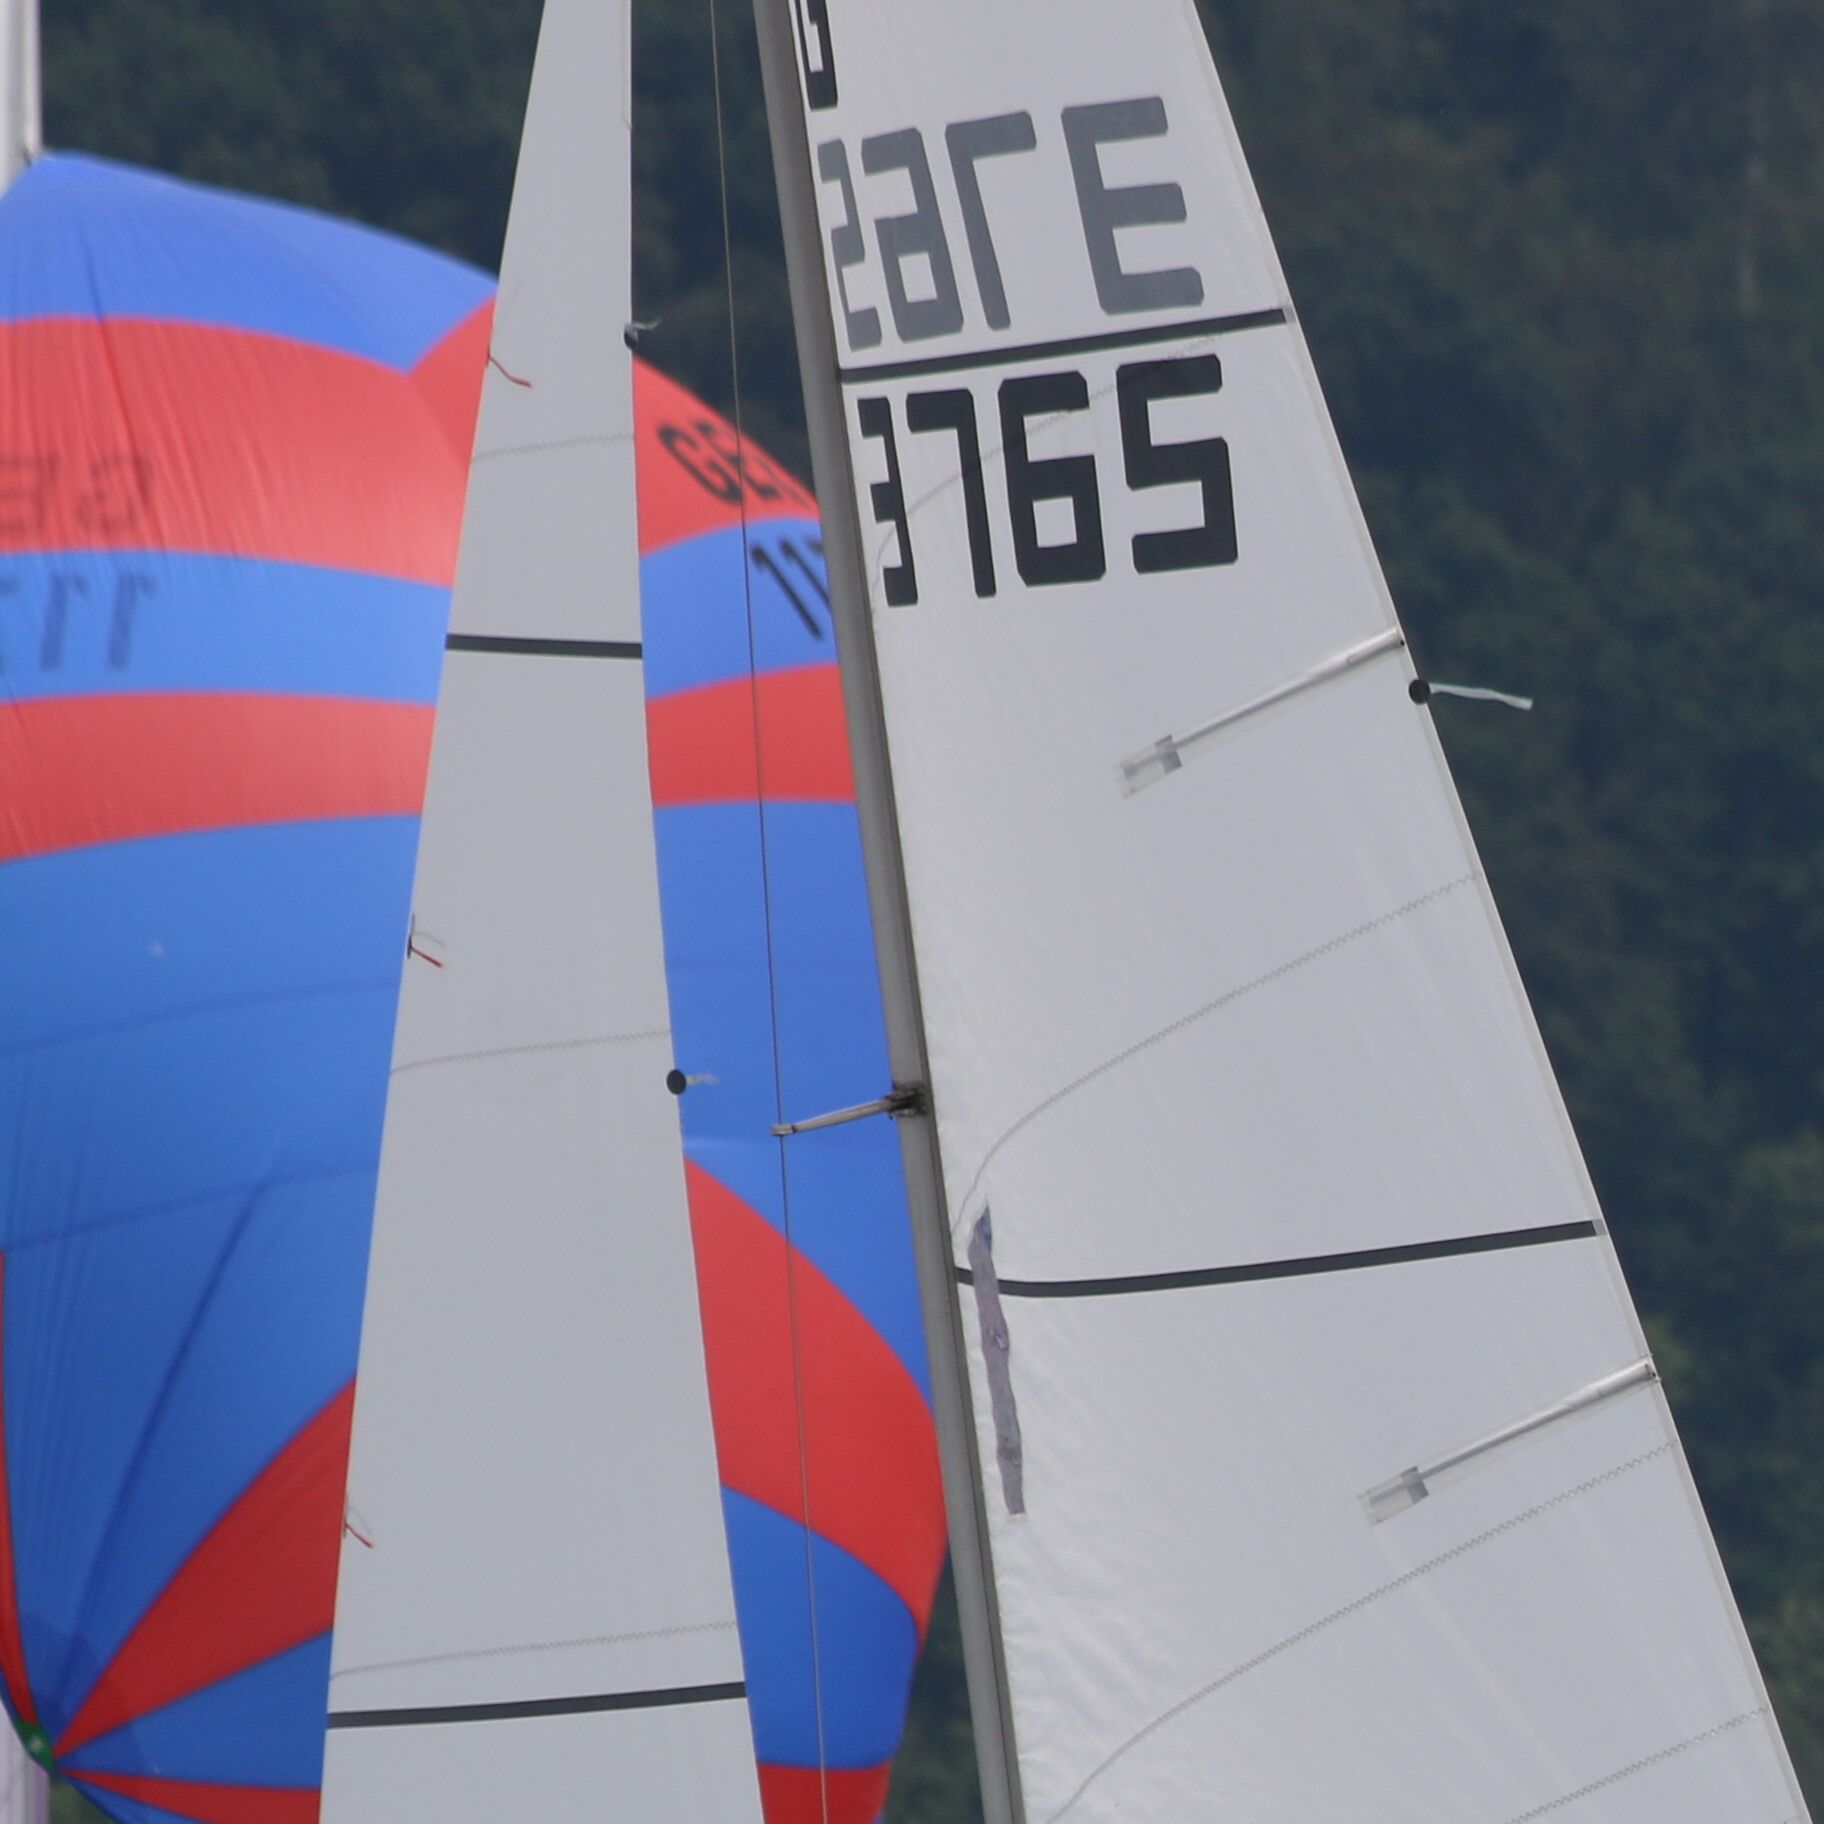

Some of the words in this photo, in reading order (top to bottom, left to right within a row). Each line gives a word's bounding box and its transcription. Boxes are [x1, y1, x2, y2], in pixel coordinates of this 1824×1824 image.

[656, 420, 808, 508] GE
[855, 353, 1239, 607] 3765
[752, 538, 828, 642] 11
